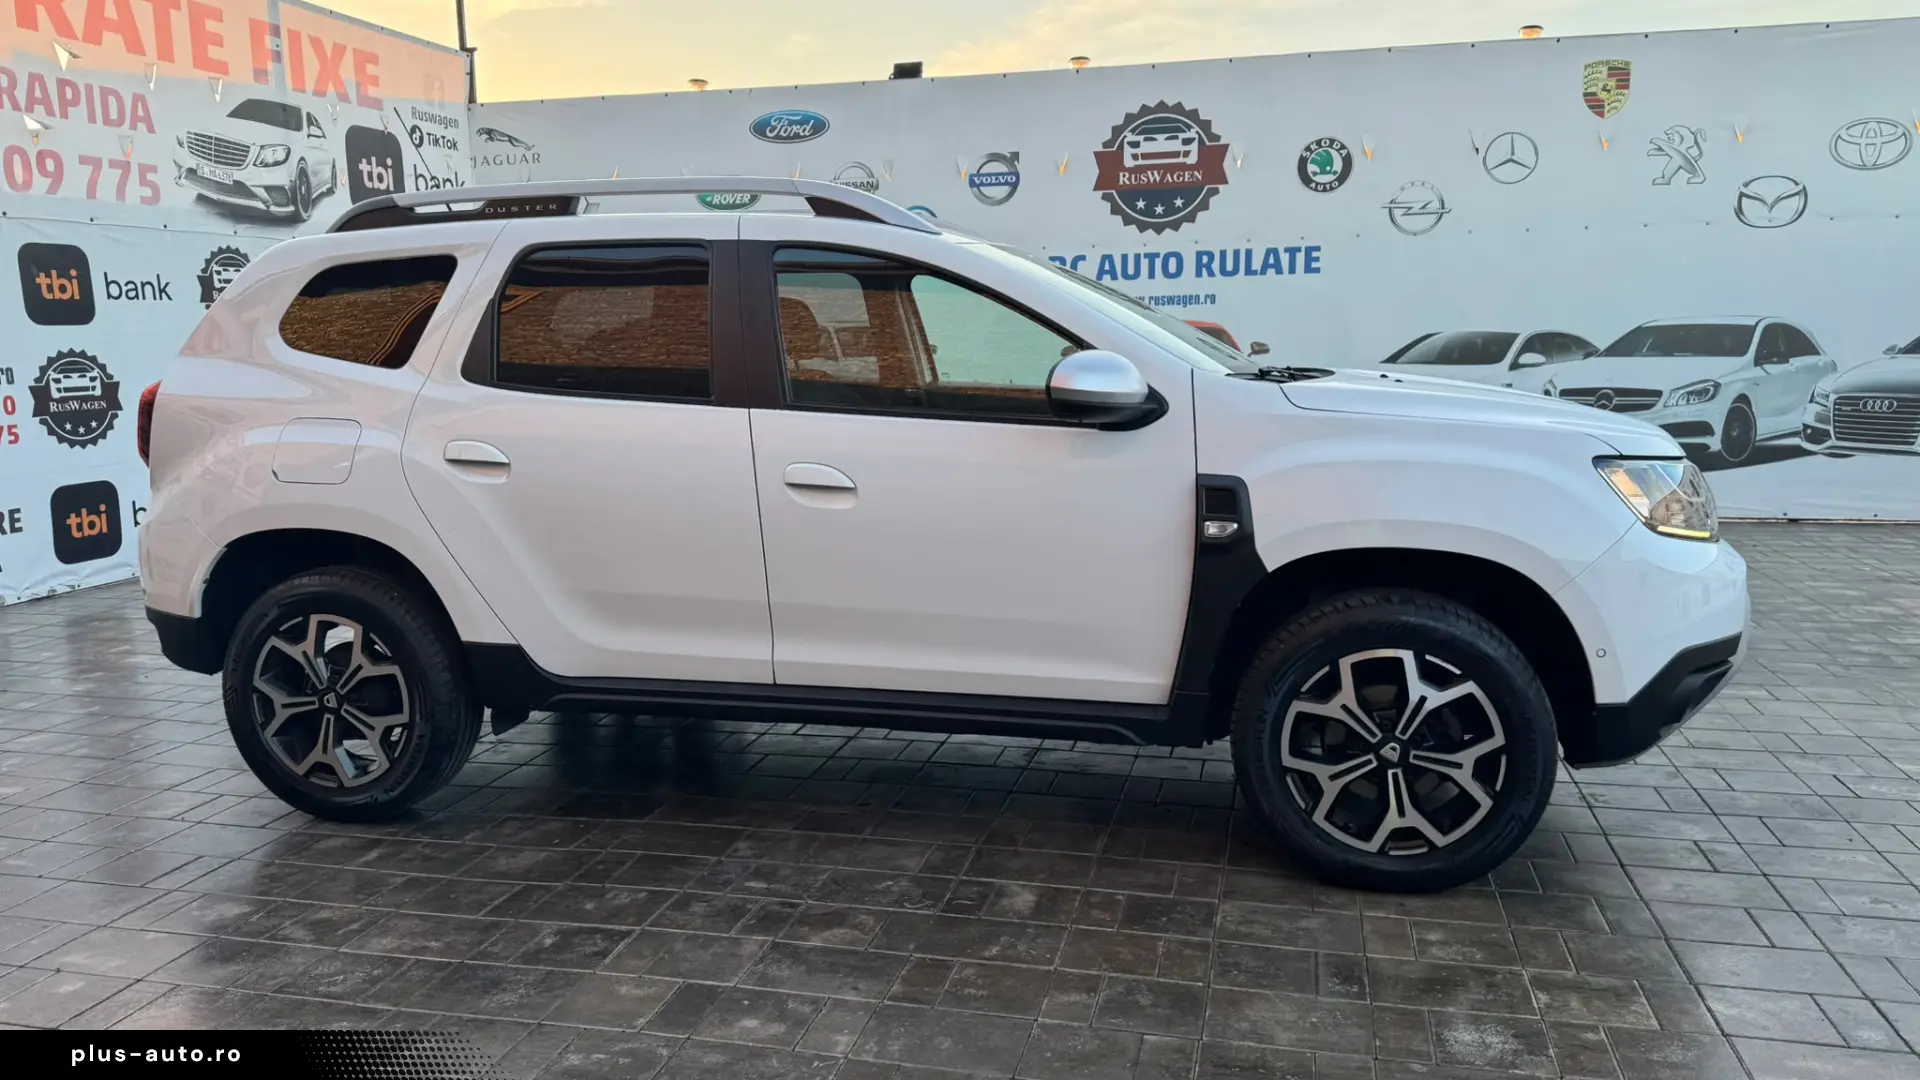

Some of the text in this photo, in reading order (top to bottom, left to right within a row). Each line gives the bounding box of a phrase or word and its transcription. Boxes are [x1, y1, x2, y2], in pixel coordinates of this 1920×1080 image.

[249, 17, 384, 111] FIXE
[0, 66, 156, 134] RAPIDA
[411, 106, 459, 129] Ruswagen
[766, 114, 814, 137] Ford
[426, 132, 459, 152] TikTok
[1302, 138, 1348, 158] SKODA
[472, 152, 541, 169] JAGUAR
[3, 144, 161, 206] 09 775
[358, 155, 394, 191] tbi
[973, 174, 1016, 184] VOLVO
[1309, 180, 1339, 192] AUTO
[485, 203, 557, 214] DUSTER
[712, 193, 751, 205] ROVER
[1095, 249, 1184, 281] AUTO
[1195, 245, 1321, 279] RULATE
[35, 268, 173, 301] tbi bank
[66, 503, 108, 539] tbi
